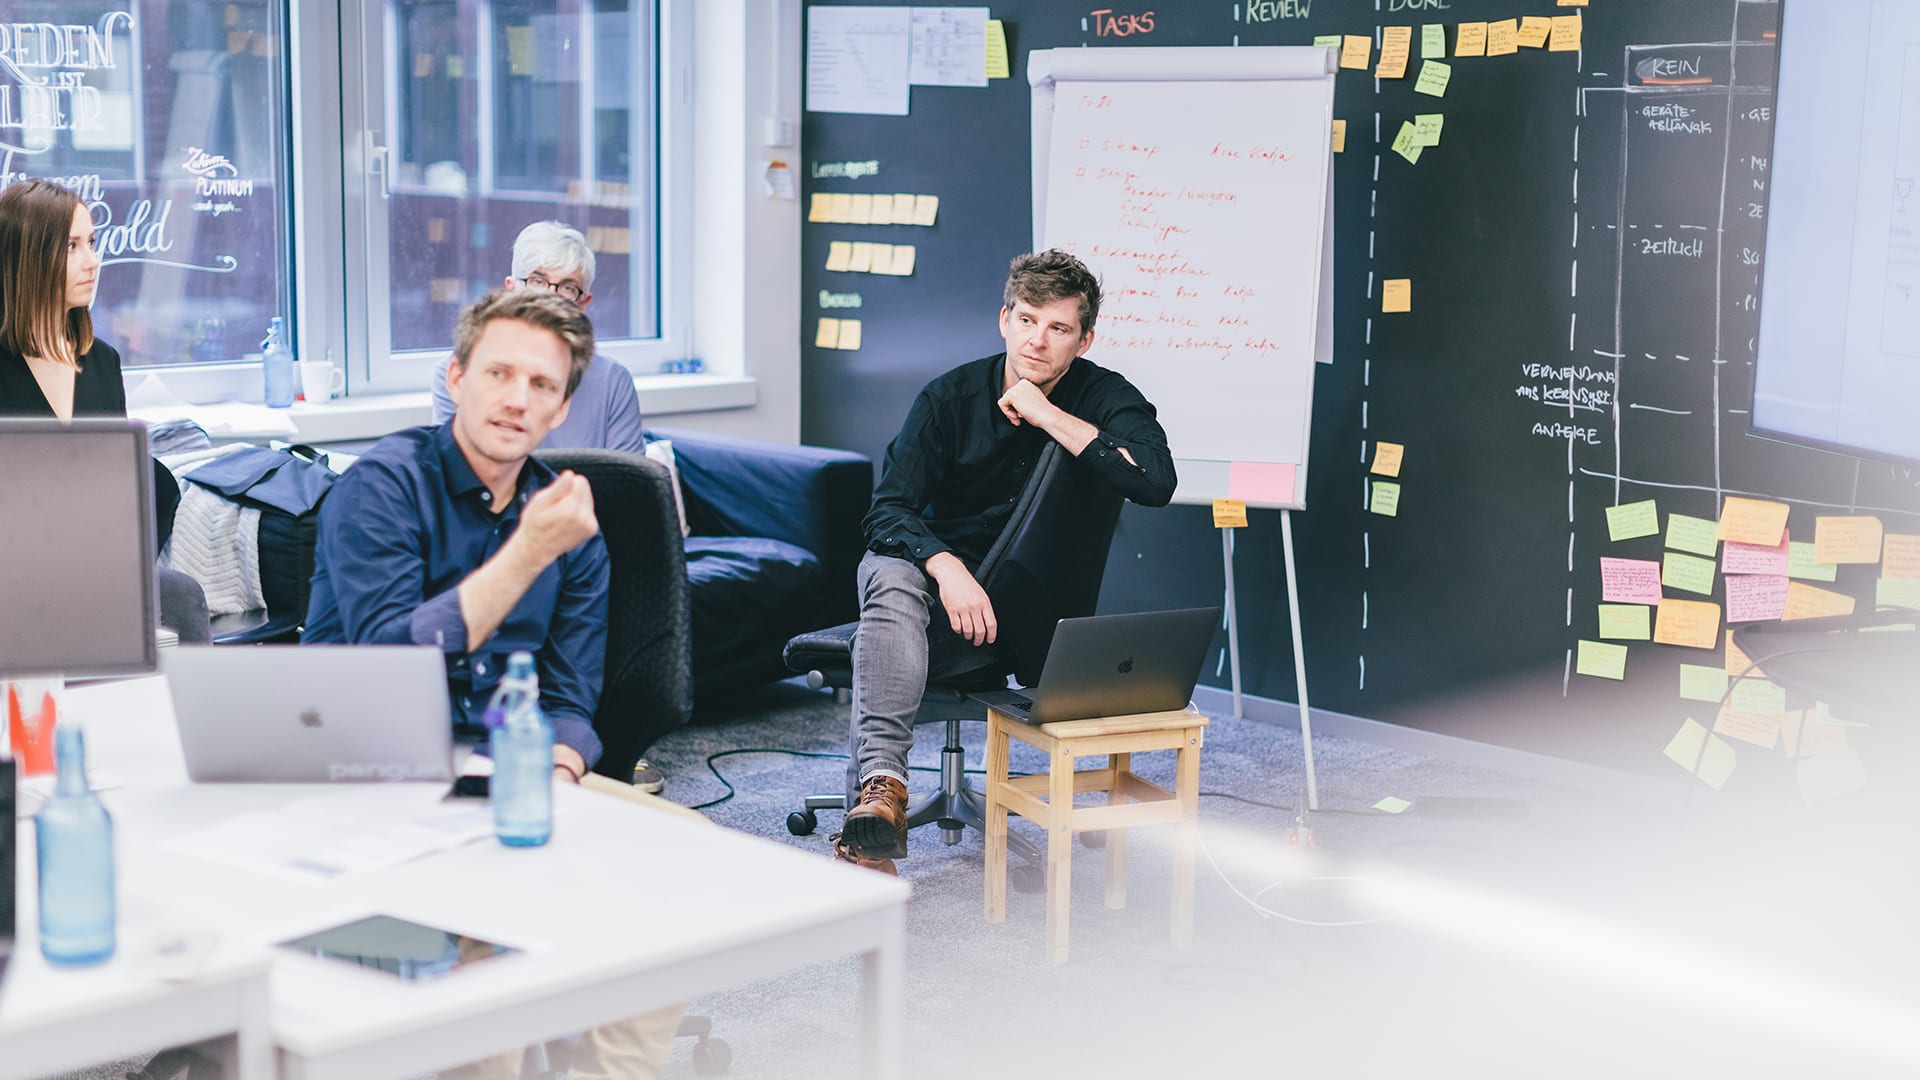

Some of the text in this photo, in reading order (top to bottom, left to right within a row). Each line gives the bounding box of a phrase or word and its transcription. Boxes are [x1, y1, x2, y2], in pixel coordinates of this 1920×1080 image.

[1246, 0, 1311, 24] REVIEW
[1090, 9, 1155, 37] TASKS
[1652, 55, 1701, 77] KEIN
[59, 71, 85, 88] IST
[196, 177, 253, 196] PLATINUM
[1641, 237, 1704, 258] ZEITLICH
[1531, 422, 1602, 445] ANZEIGE
[328, 762, 449, 782] penguin
